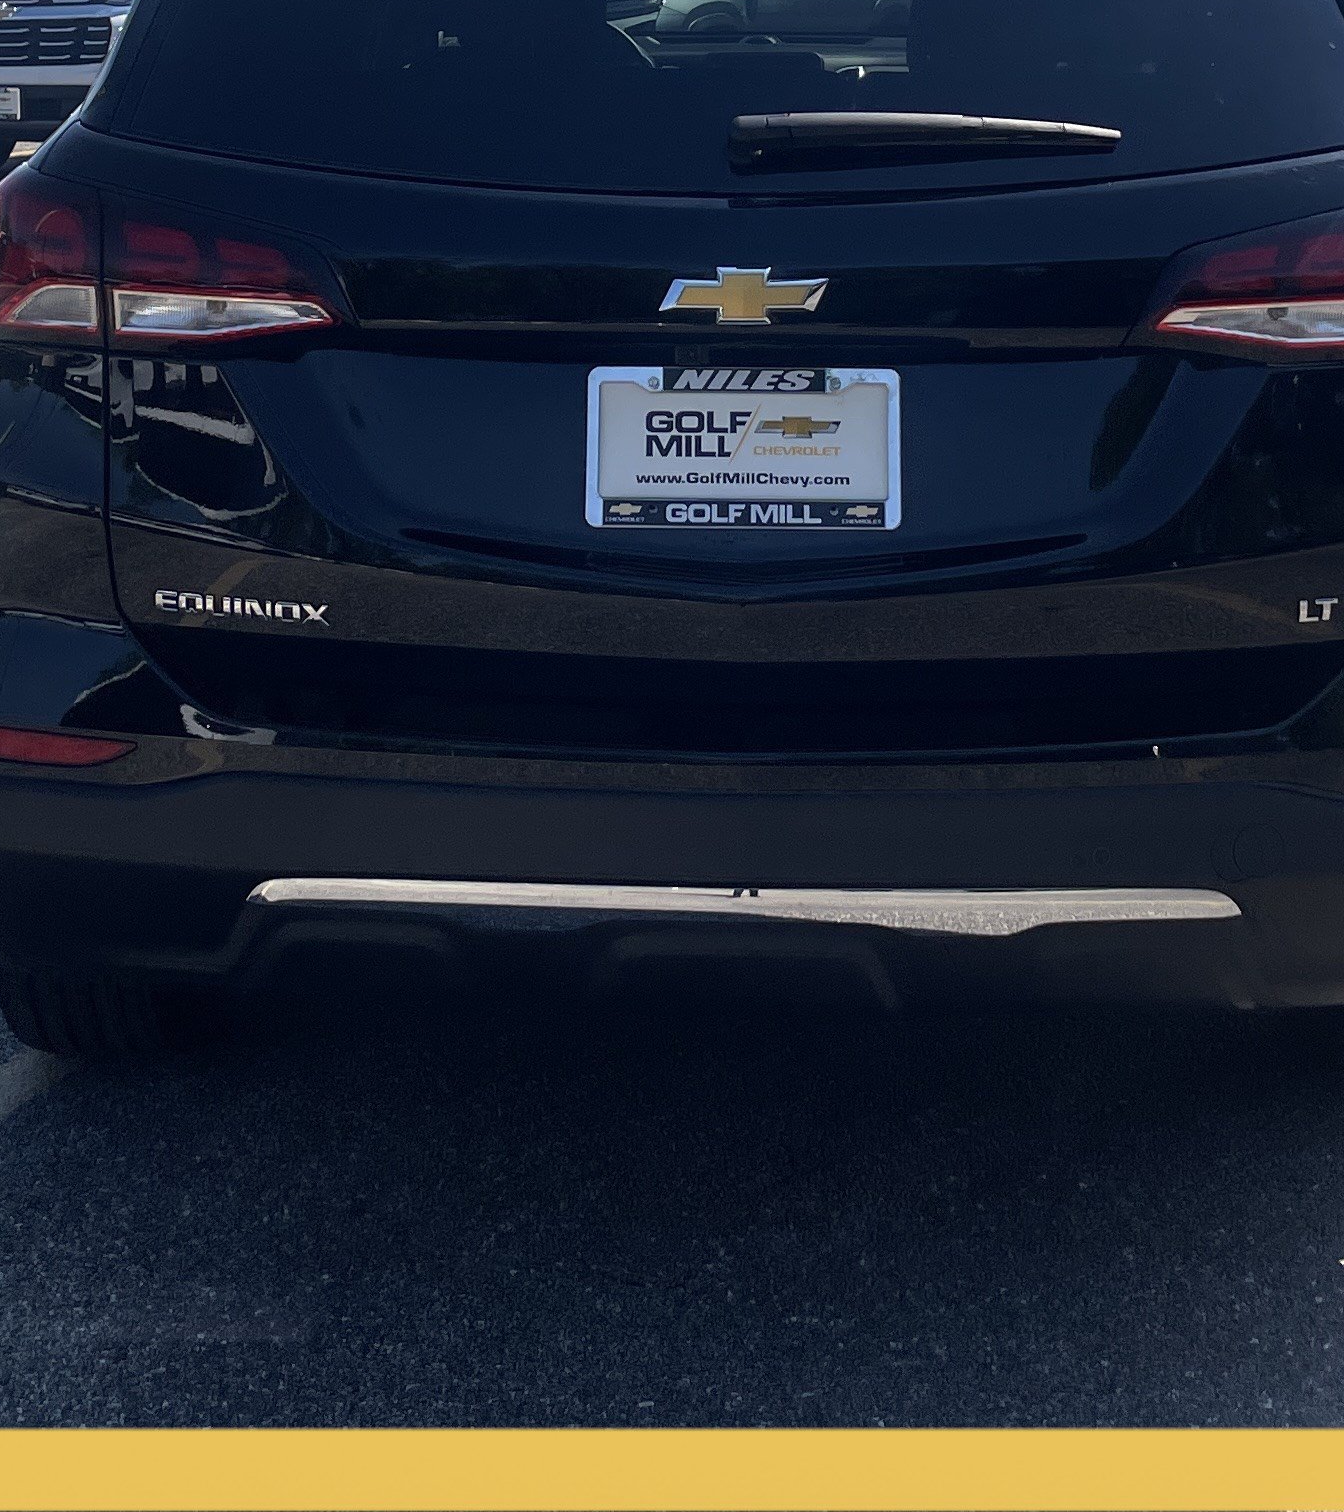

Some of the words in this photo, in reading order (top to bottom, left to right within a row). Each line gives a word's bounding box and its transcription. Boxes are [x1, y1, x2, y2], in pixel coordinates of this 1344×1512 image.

[672, 369, 815, 391] NILES
[645, 410, 753, 434] GOLF
[645, 434, 733, 458] MILL
[752, 445, 842, 457] CHEVROLET
[635, 471, 851, 488] www.GolfMillChevy.com
[665, 503, 746, 524] GOLF
[750, 503, 822, 525] MILL
[155, 589, 331, 627] EQUINOX
[1298, 597, 1339, 623] LT
